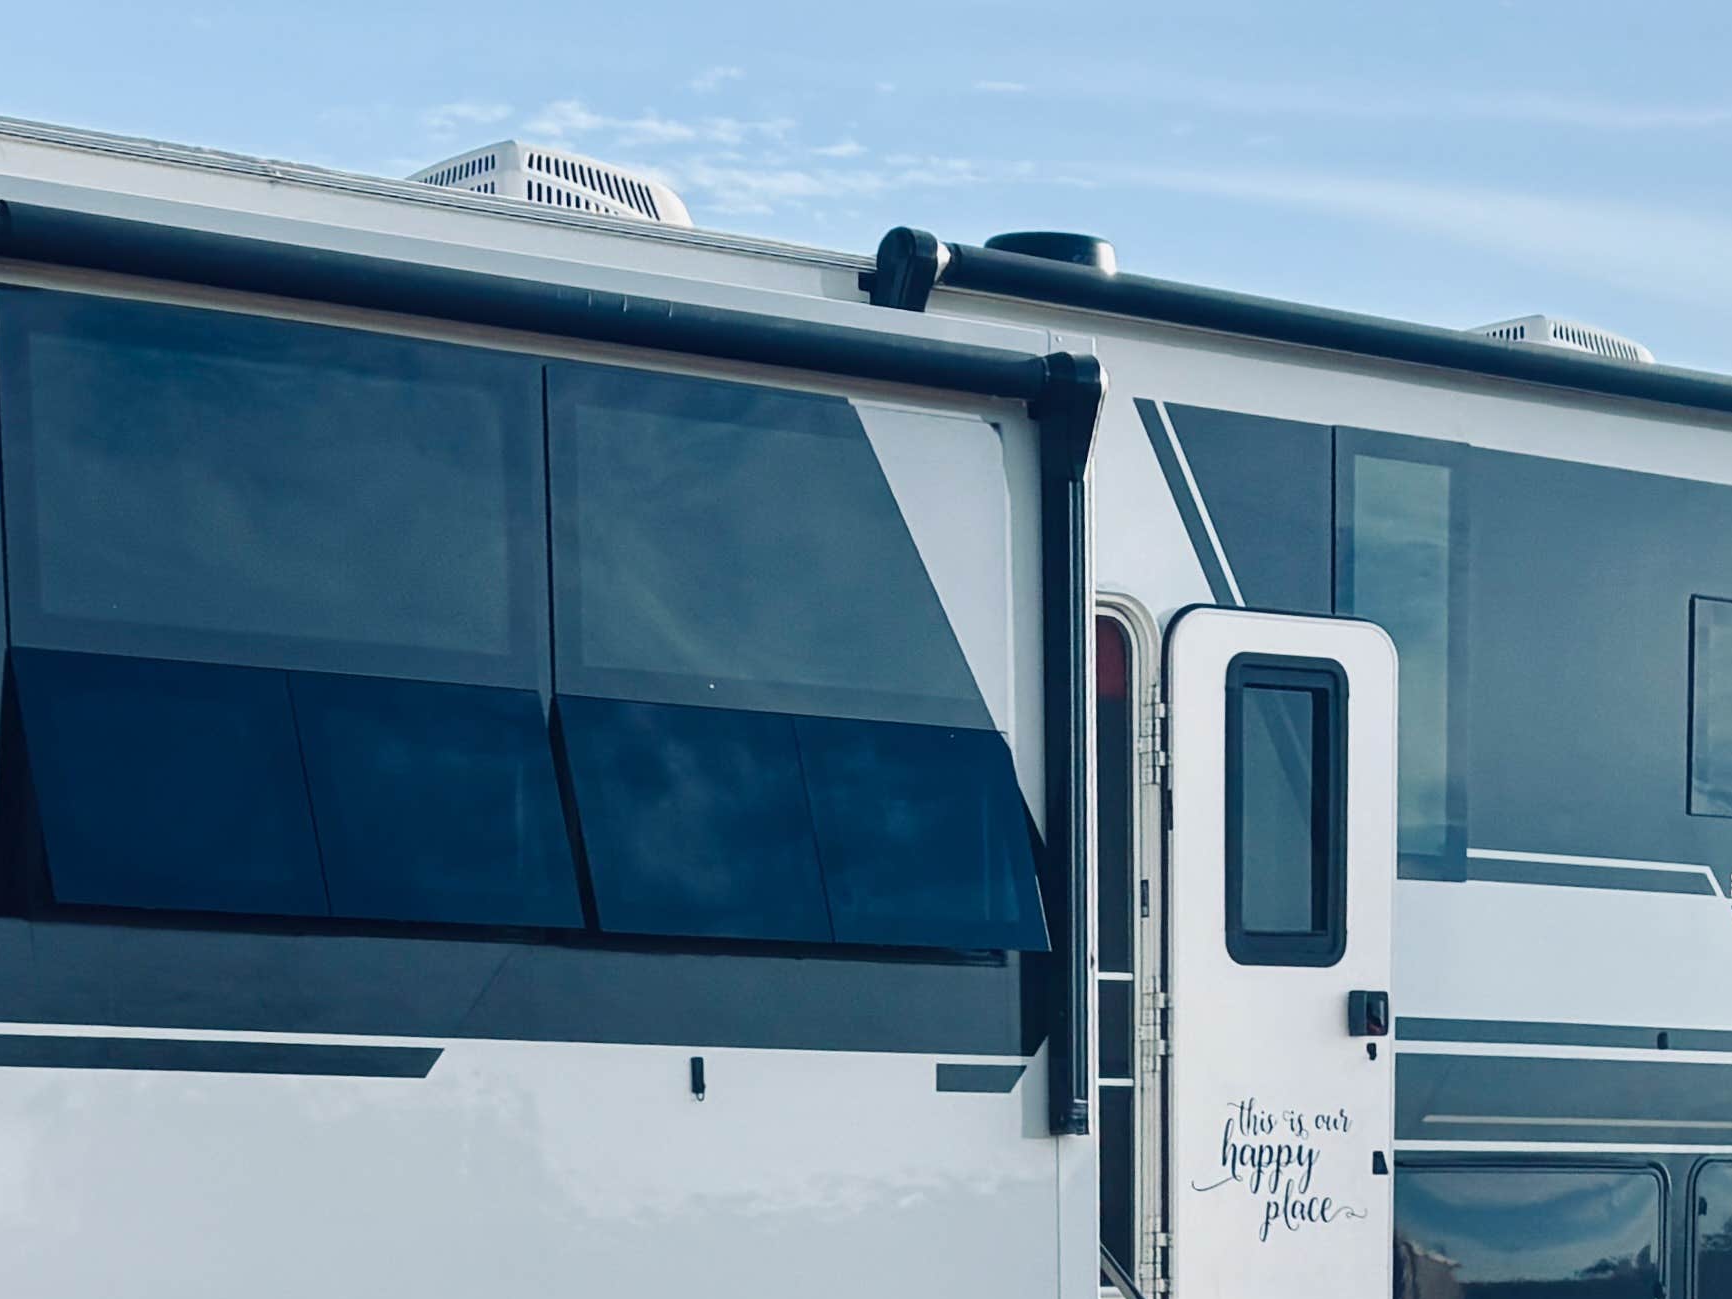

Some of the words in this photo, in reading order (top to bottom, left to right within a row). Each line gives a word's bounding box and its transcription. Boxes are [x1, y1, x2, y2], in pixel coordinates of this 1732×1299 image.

[1226, 1097, 1277, 1136] this
[1282, 1110, 1309, 1139] is
[1315, 1108, 1352, 1132] our
[1192, 1118, 1320, 1194] happy
[1259, 1178, 1367, 1242] place
